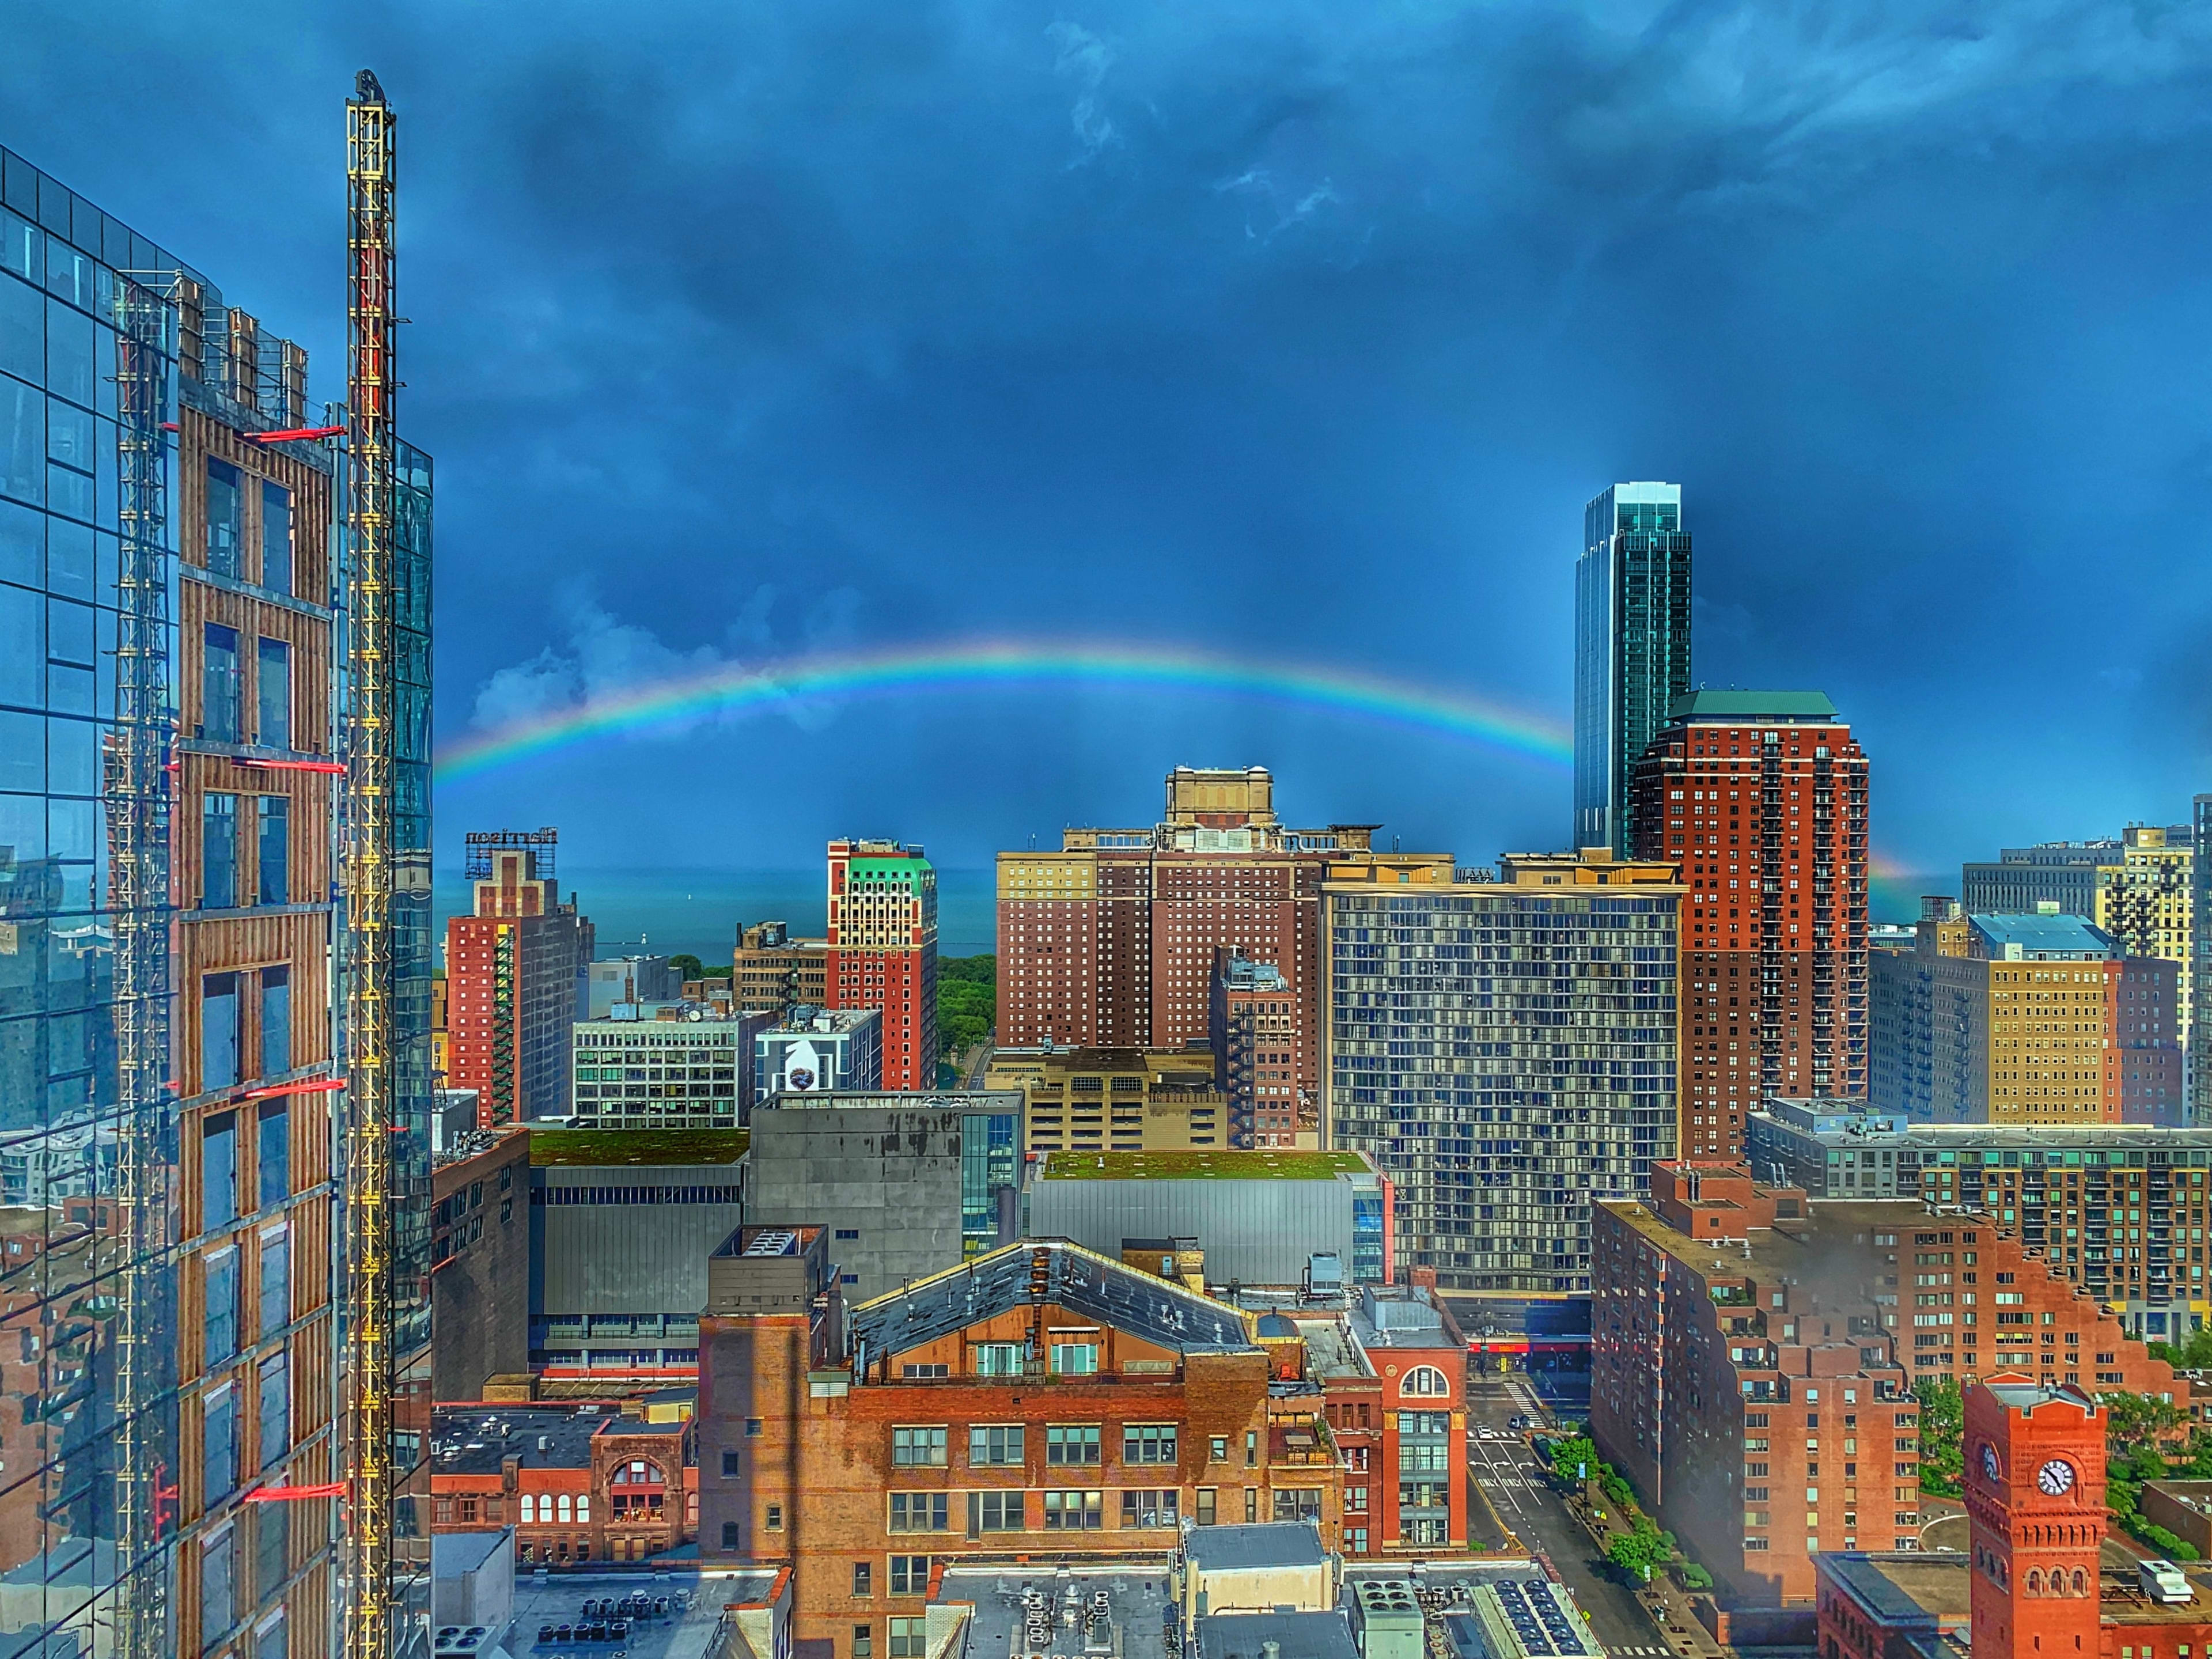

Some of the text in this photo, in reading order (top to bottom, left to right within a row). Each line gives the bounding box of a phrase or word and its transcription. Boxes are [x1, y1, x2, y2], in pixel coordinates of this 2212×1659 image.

[1478, 1478, 1499, 1487] ONLY
[1501, 1478, 1523, 1487] ONLY
[1527, 1479, 1548, 1487] ONLY
